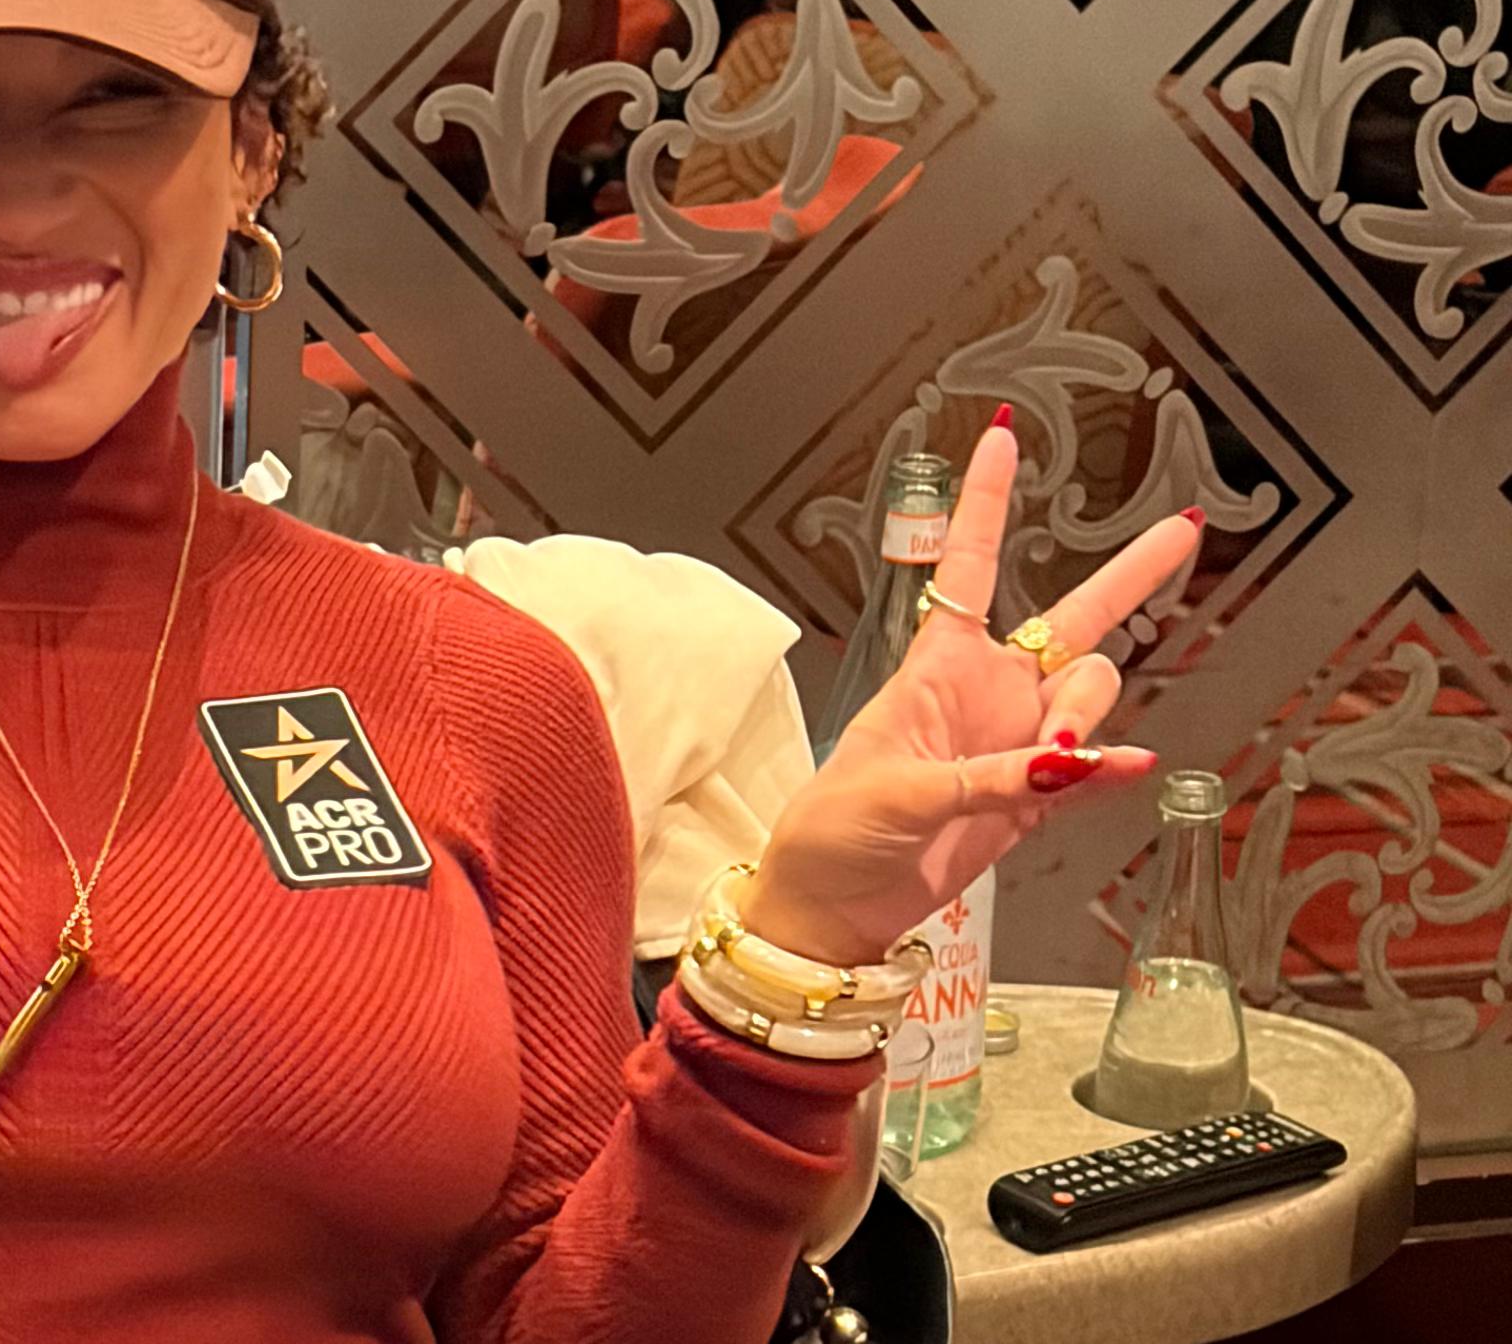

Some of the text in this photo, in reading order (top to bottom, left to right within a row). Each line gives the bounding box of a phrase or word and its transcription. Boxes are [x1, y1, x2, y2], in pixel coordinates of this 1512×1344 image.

[286, 797, 385, 832] ACR
[294, 826, 402, 869] PRO
[904, 968, 987, 1025] ANN
